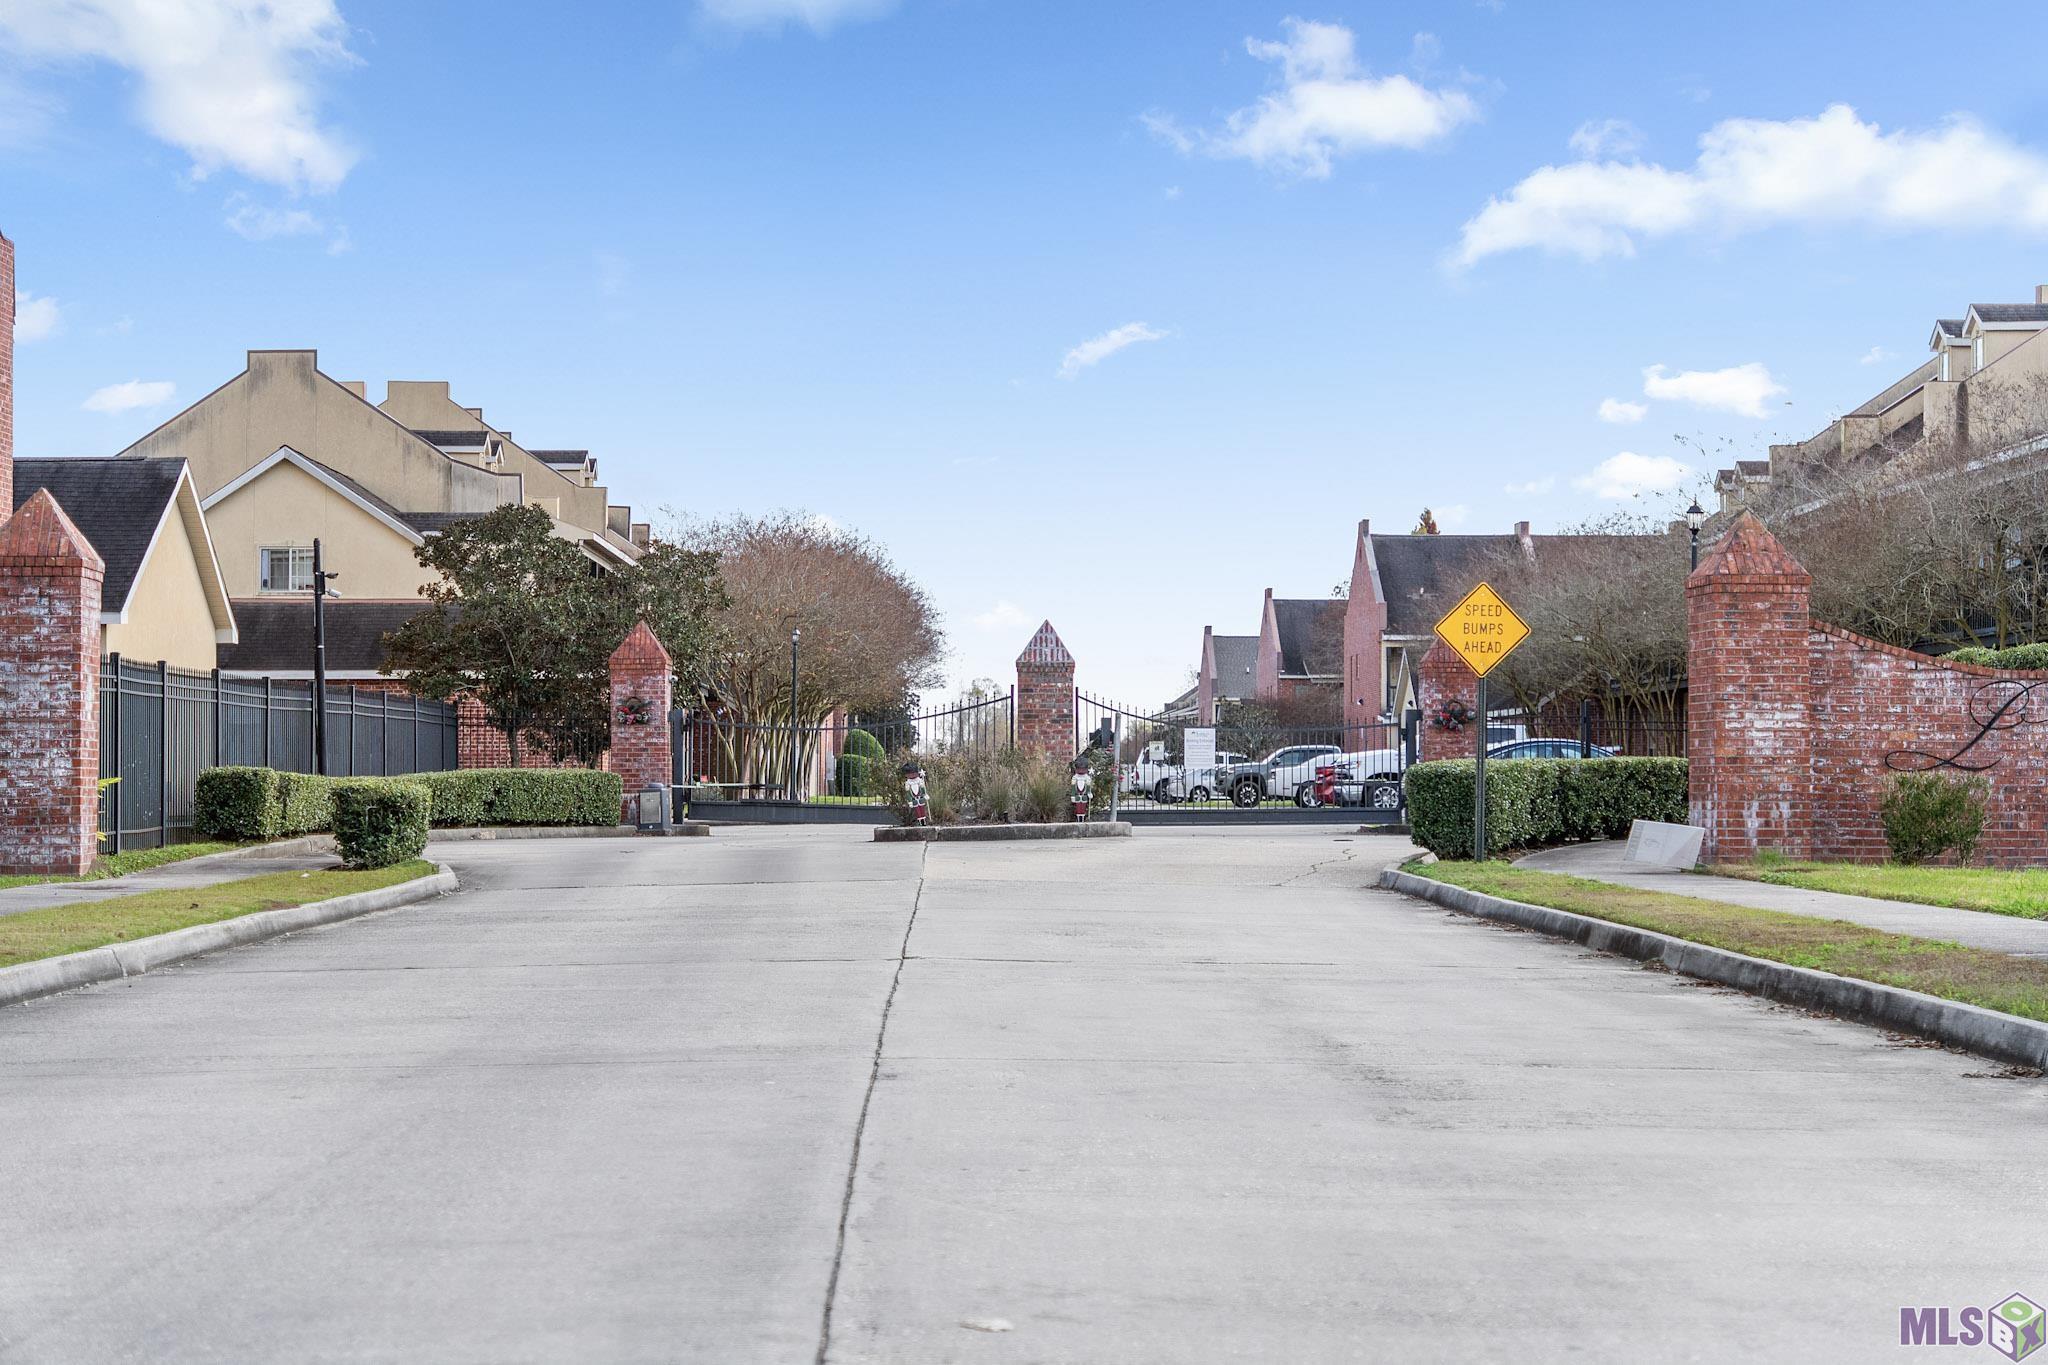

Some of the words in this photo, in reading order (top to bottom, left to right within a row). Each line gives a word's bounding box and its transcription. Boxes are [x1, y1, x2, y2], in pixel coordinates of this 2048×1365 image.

[1465, 604, 1502, 617] SPEED
[1463, 622, 1504, 636] BUMPS
[1463, 641, 1502, 654] AHEAD
